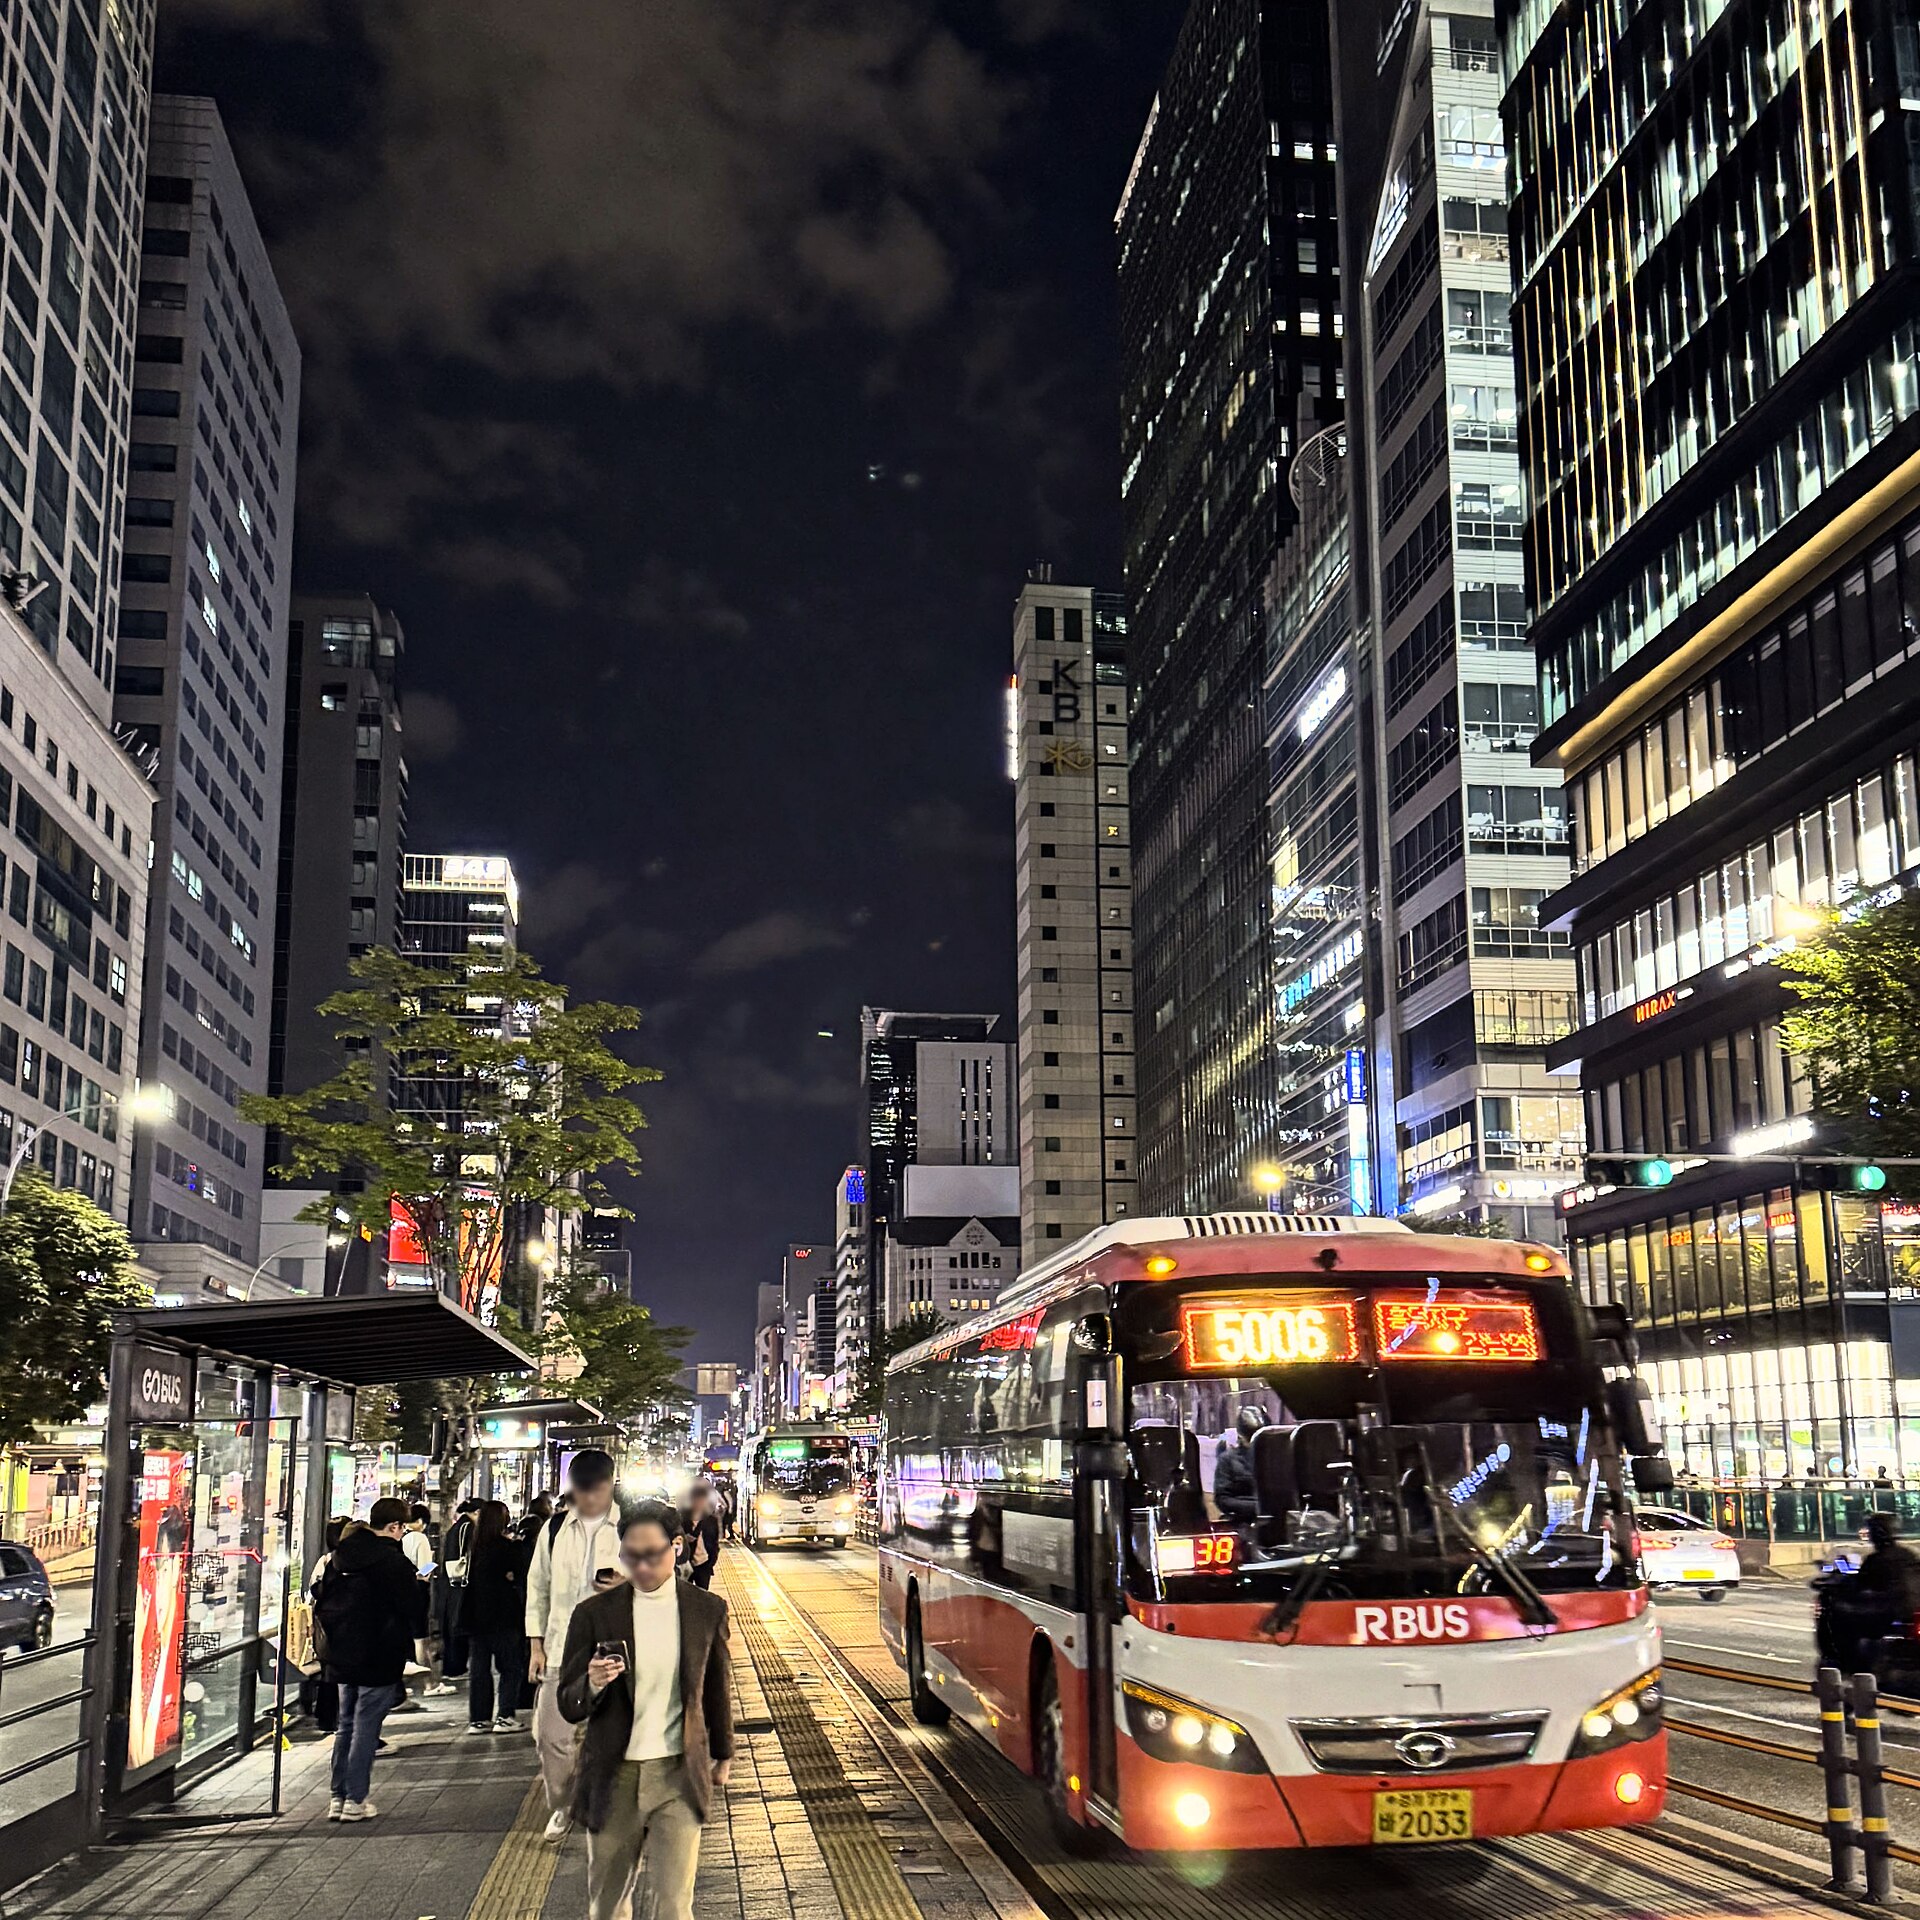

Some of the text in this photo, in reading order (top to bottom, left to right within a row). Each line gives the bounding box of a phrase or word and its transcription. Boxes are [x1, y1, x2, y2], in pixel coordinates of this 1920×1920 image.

[1054, 659, 1081, 722] KB
[1635, 990, 1676, 1024] HIRAX
[1212, 1308, 1330, 1362] 5006
[1196, 1535, 1235, 1566] 38
[1399, 1810, 1468, 1838] 2033
